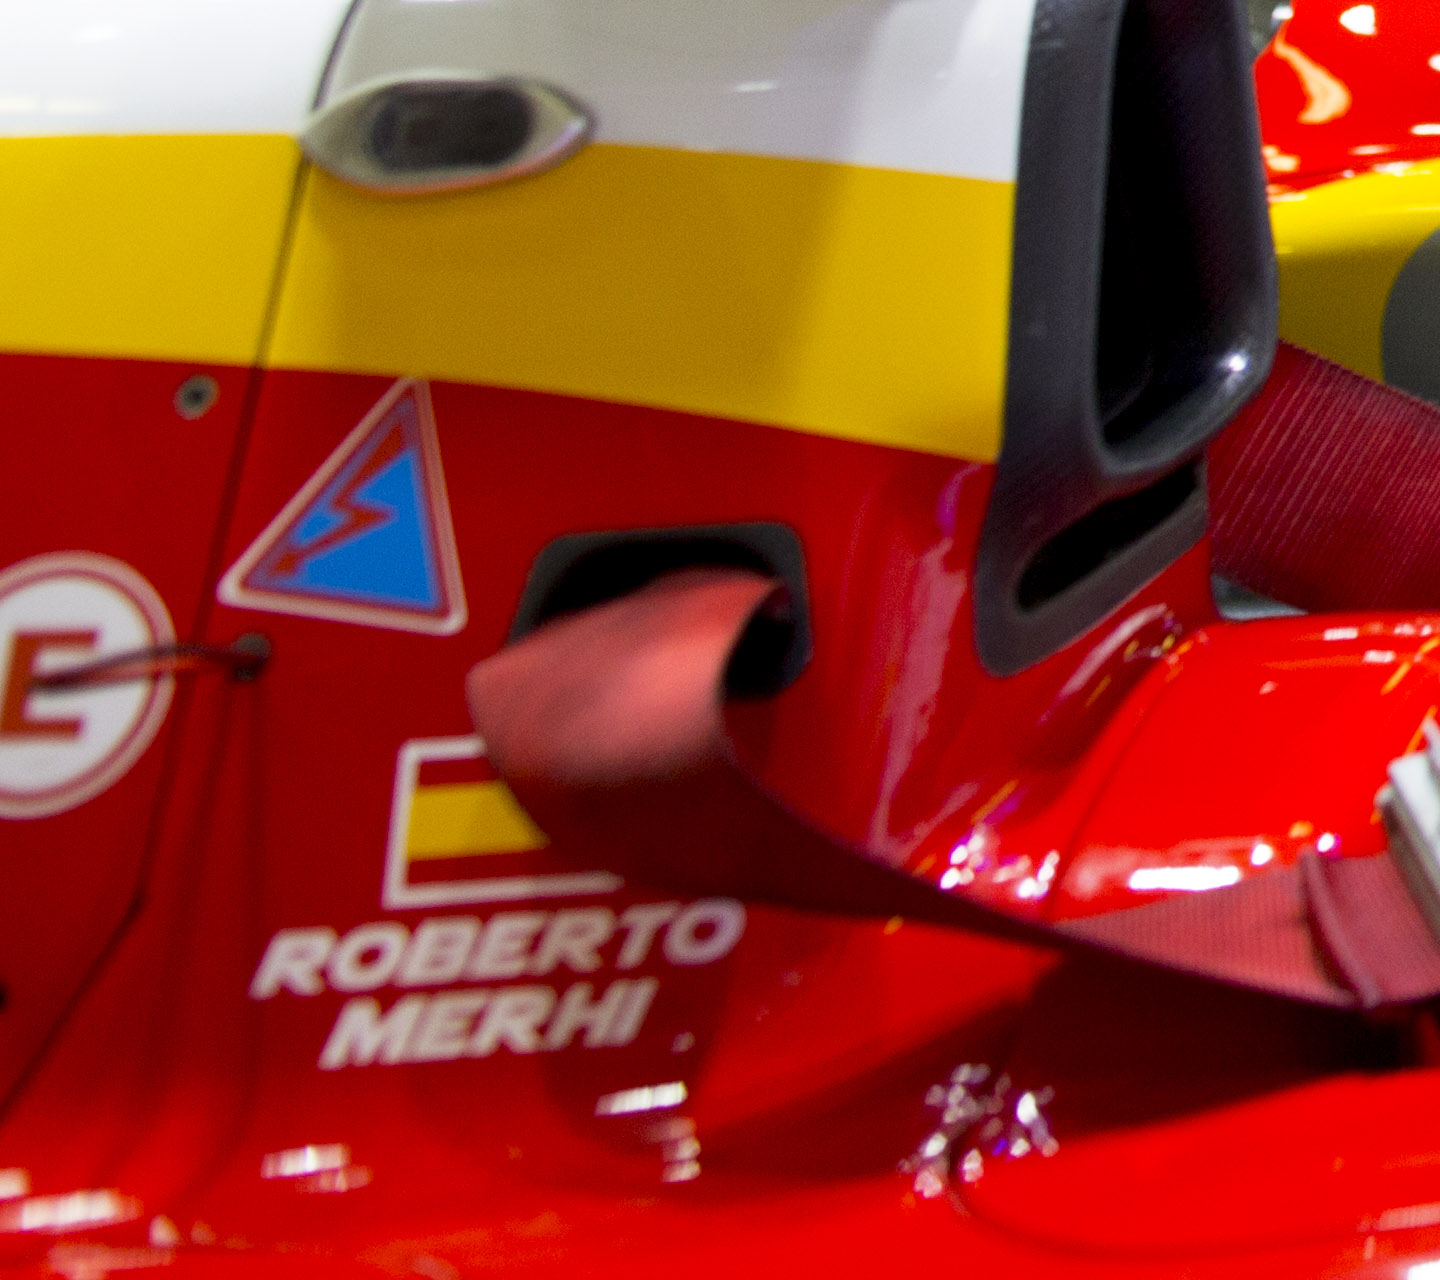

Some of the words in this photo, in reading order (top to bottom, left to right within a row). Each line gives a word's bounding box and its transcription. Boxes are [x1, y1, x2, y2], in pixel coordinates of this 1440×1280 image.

[0, 628, 99, 739] E
[248, 897, 748, 1000] ROBERTO
[318, 976, 661, 1071] MERHI
